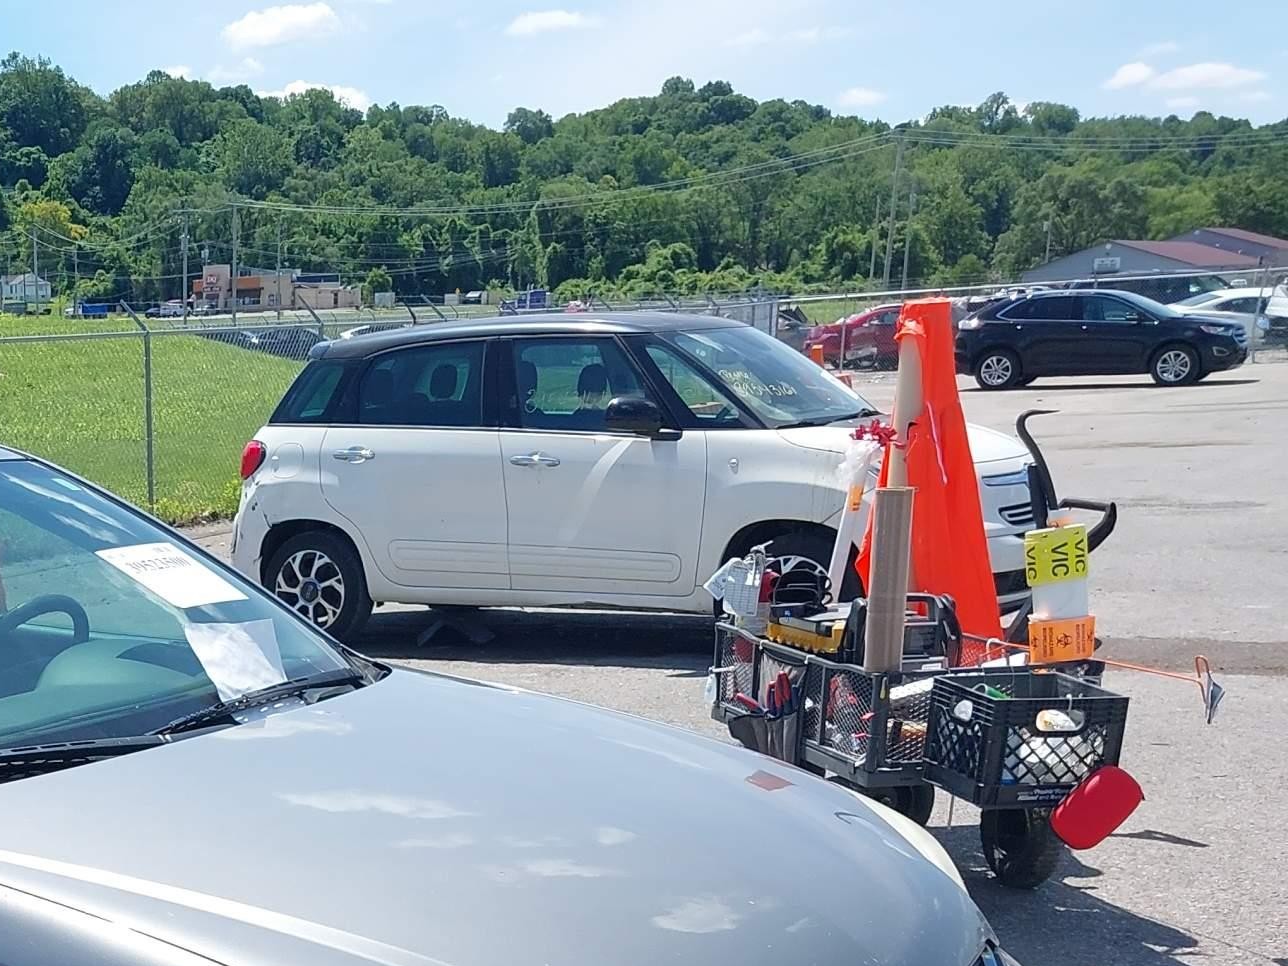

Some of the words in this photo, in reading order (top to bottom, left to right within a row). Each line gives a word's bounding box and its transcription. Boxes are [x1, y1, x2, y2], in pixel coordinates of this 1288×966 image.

[1026, 547, 1038, 581] VIC
[1051, 542, 1070, 577] VIC
[1074, 538, 1087, 573] VIC
